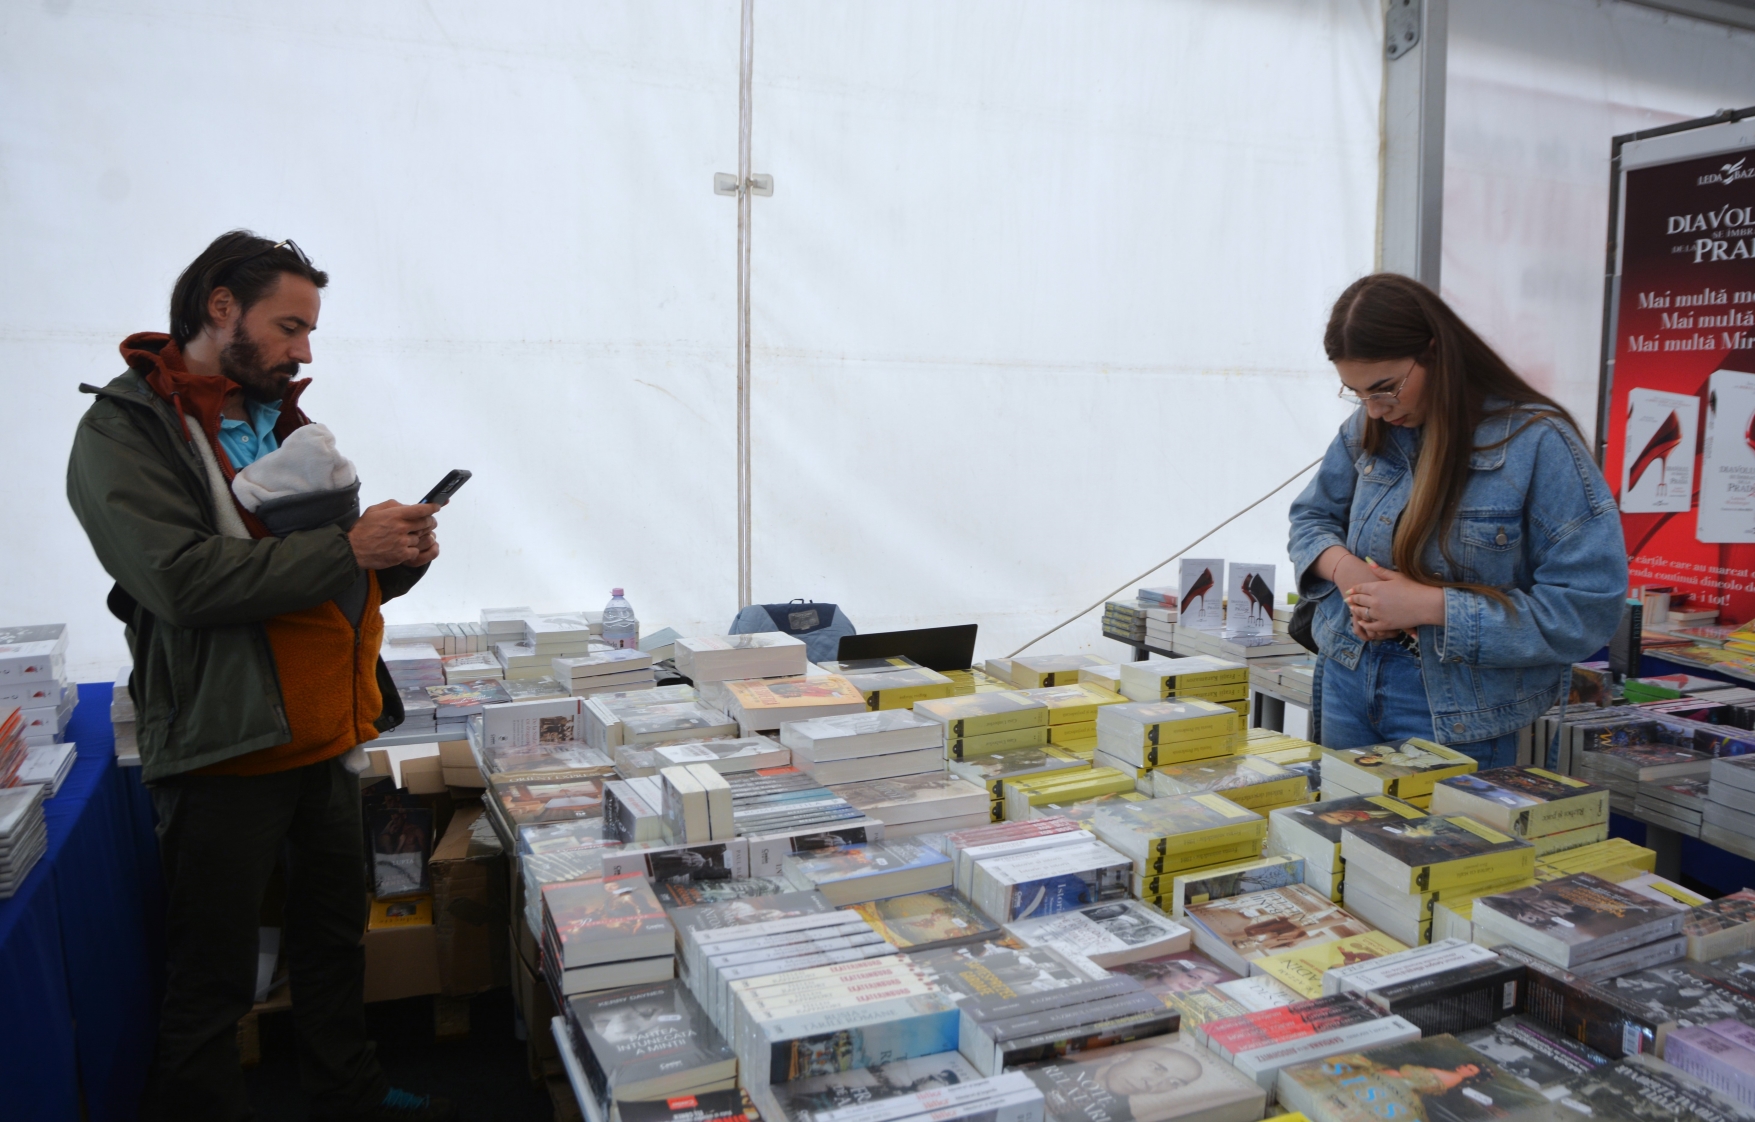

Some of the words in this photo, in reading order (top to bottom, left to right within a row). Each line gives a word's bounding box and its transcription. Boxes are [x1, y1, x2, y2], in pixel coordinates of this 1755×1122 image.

[1697, 174, 1722, 186] LEDA
[1733, 168, 1755, 180] BAZ
[1666, 204, 1755, 234] DIAVOL
[1726, 228, 1755, 238] ÎMBR
[1638, 290, 1670, 309] Mai
[1674, 288, 1728, 308] multă
[1660, 311, 1694, 330] Mai
[1697, 309, 1754, 328] multă
[1627, 334, 1660, 352] Mai
[1664, 333, 1715, 352] multă
[1670, 560, 1692, 570] care
[1694, 563, 1706, 572] au
[1708, 565, 1748, 577] marcat
[1700, 576, 1742, 591] dincolo
[598, 996, 627, 1008] KERRY
[630, 988, 664, 1001] DAYNES
[629, 1027, 678, 1042] PARTEA
[1322, 1063, 1420, 1122] SISS
